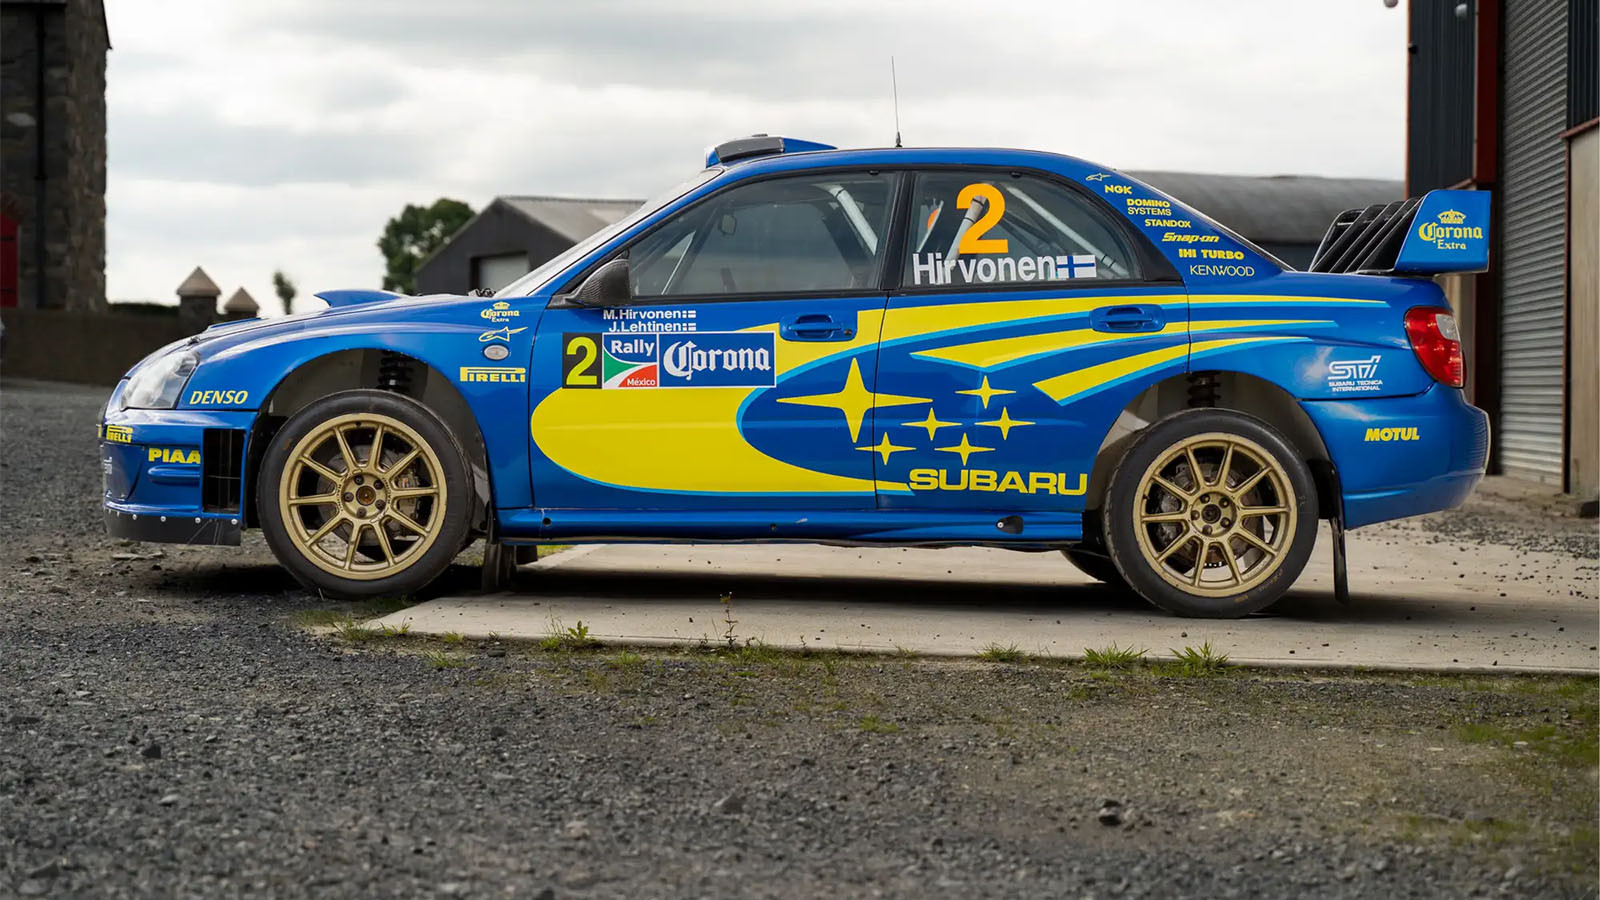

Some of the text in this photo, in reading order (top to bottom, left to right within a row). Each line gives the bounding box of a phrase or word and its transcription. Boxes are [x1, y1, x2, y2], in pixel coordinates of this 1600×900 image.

[1104, 184, 1132, 194] NGK
[1126, 198, 1171, 208] DOMINO
[1127, 207, 1172, 216] SYSTEMS
[956, 183, 1008, 254] 2
[1144, 218, 1191, 228] STANDOX
[1162, 232, 1220, 243] Snap-on
[1418, 221, 1483, 243] Corona
[1437, 239, 1466, 250] Extra
[1178, 248, 1245, 260] IHI TURBO
[912, 252, 1057, 285] Hirvonen
[1190, 265, 1255, 277] KENWOOD
[480, 308, 520, 319] Corona
[603, 309, 681, 320] M.Hirvonen
[609, 321, 681, 332] J.Lehtinen
[611, 339, 655, 356] Rally
[566, 336, 597, 385] 2
[663, 340, 771, 380] Corona
[460, 367, 526, 382] PIRELLI
[627, 377, 656, 386] México
[189, 390, 249, 405] DENSO
[1364, 427, 1420, 442] MOTUL
[148, 447, 201, 464] PIAA
[909, 468, 1088, 496] SUBARU
